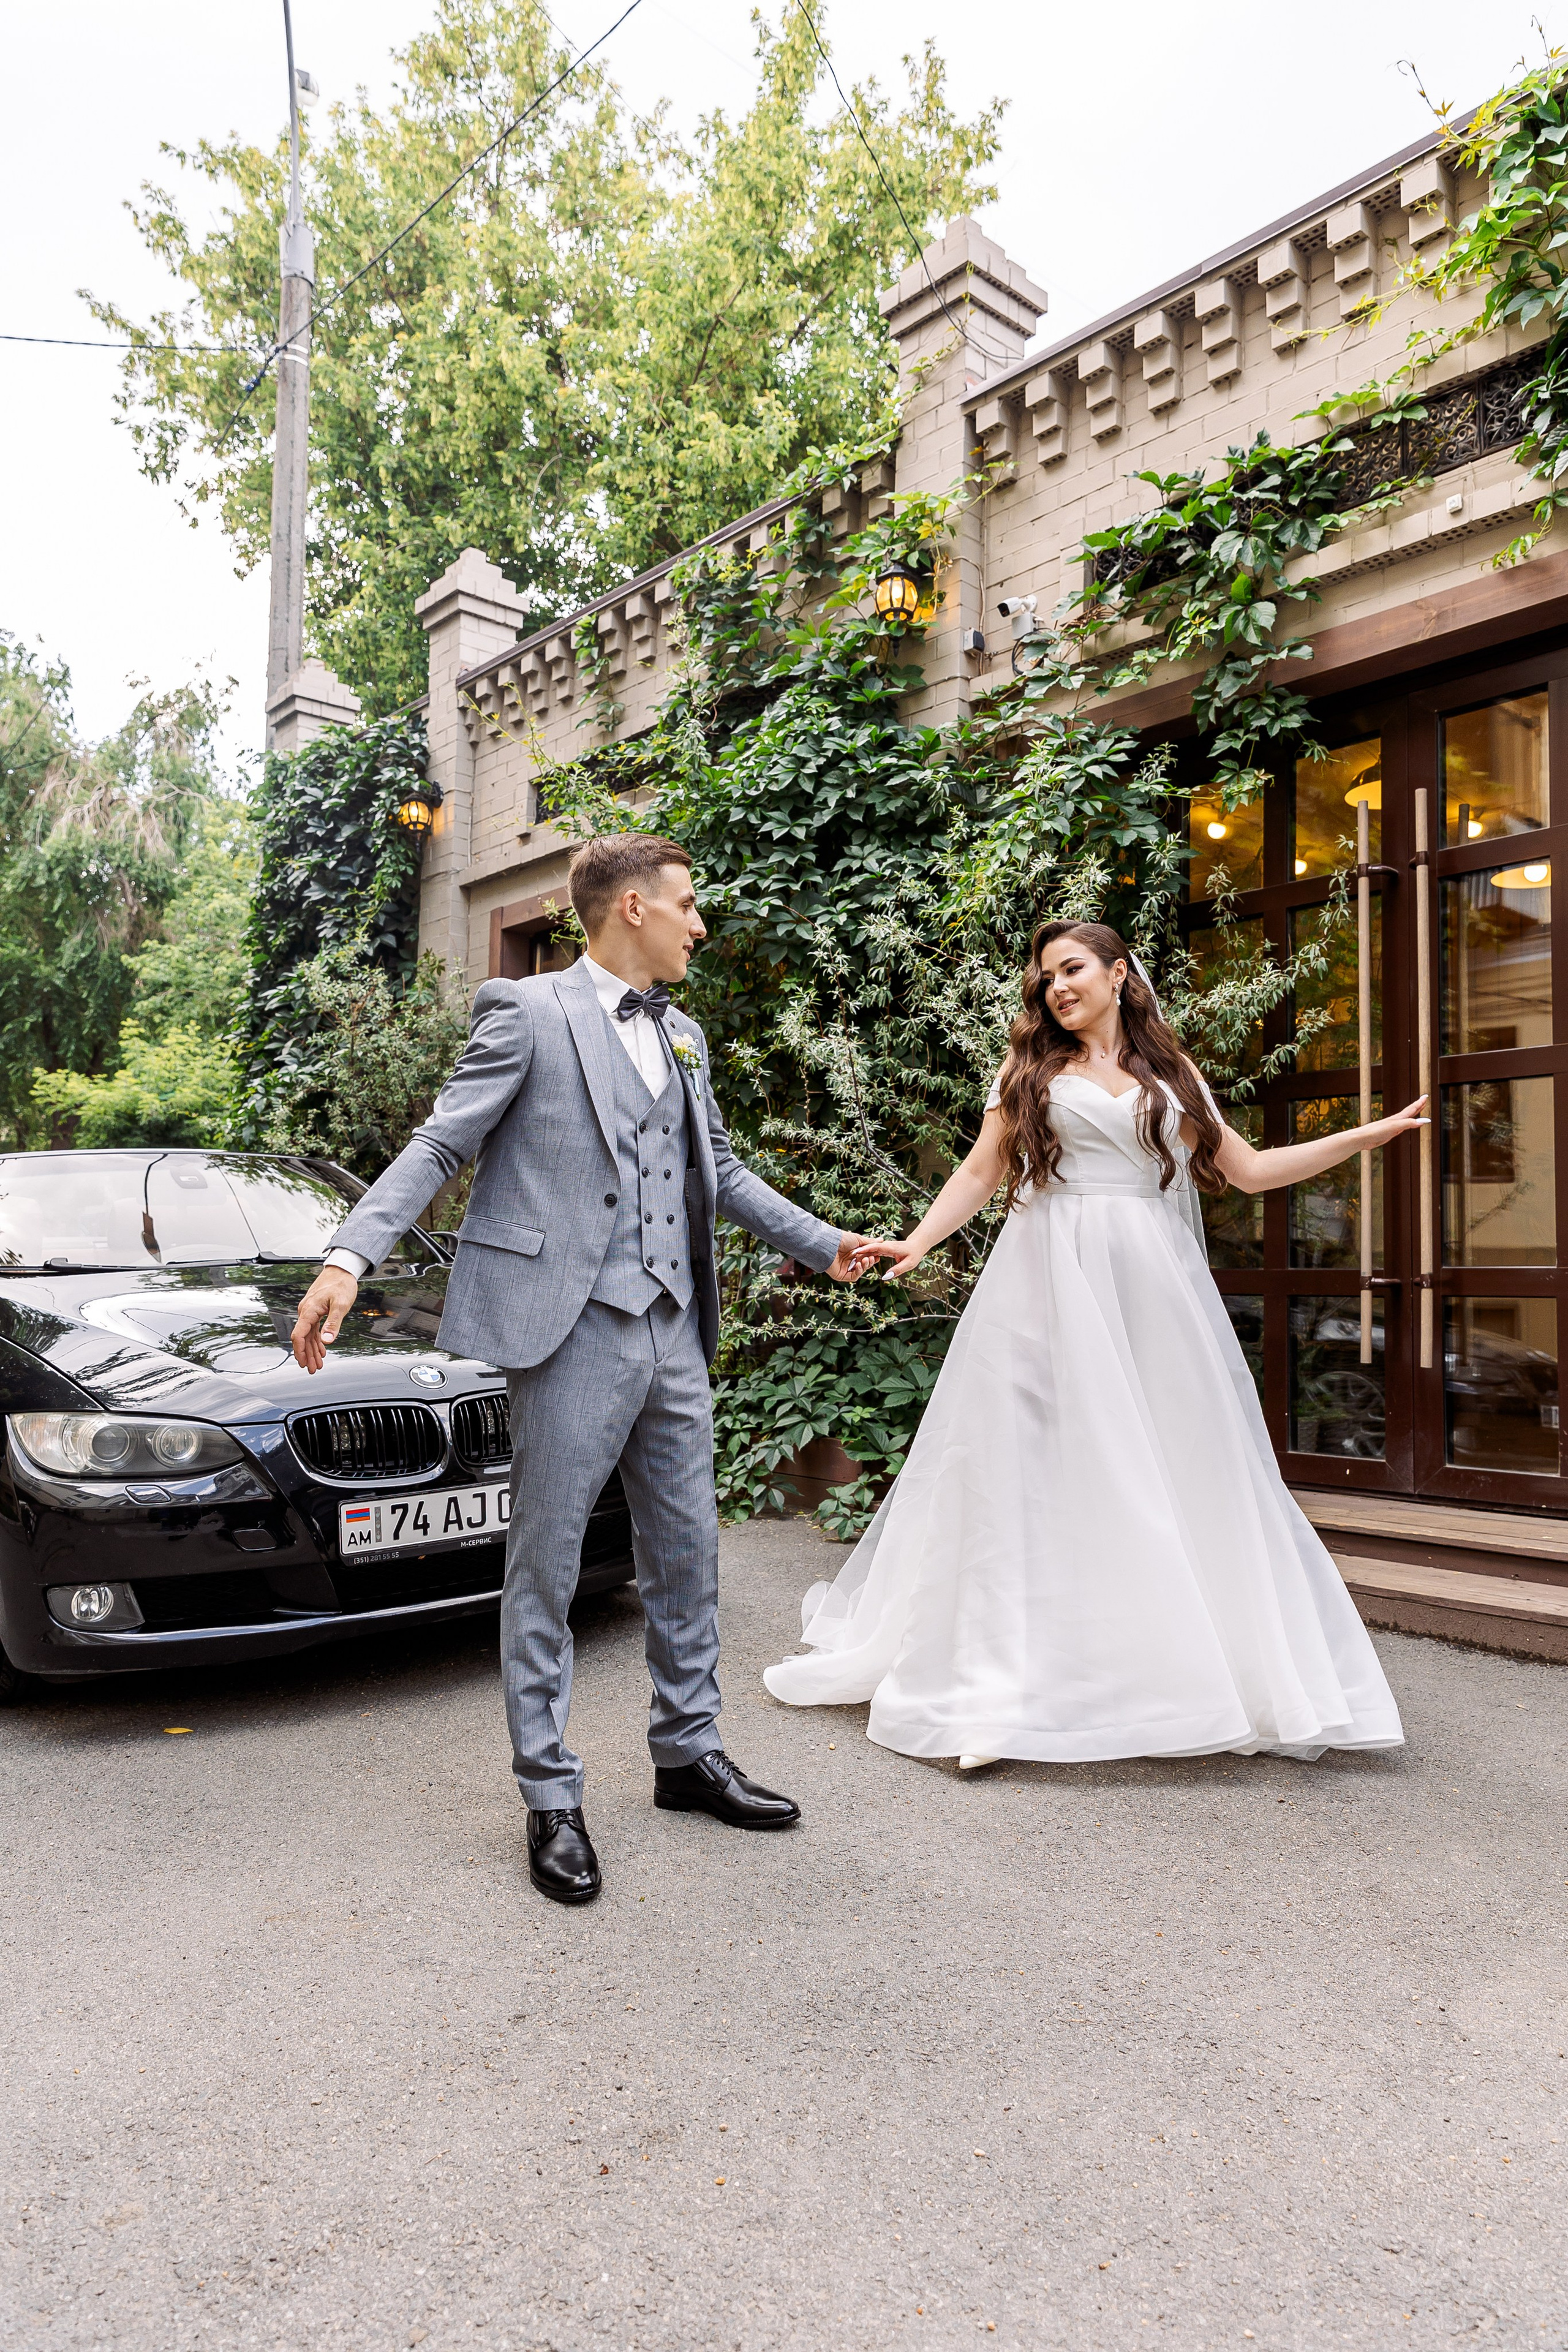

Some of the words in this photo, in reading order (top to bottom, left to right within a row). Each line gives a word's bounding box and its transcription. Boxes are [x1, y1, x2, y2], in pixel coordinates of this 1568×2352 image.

[391, 1501, 430, 1540] 74
[347, 1529, 371, 1547] AM
[461, 1537, 492, 1548] М-СЕРВИС
[353, 1556, 369, 1565] (351)
